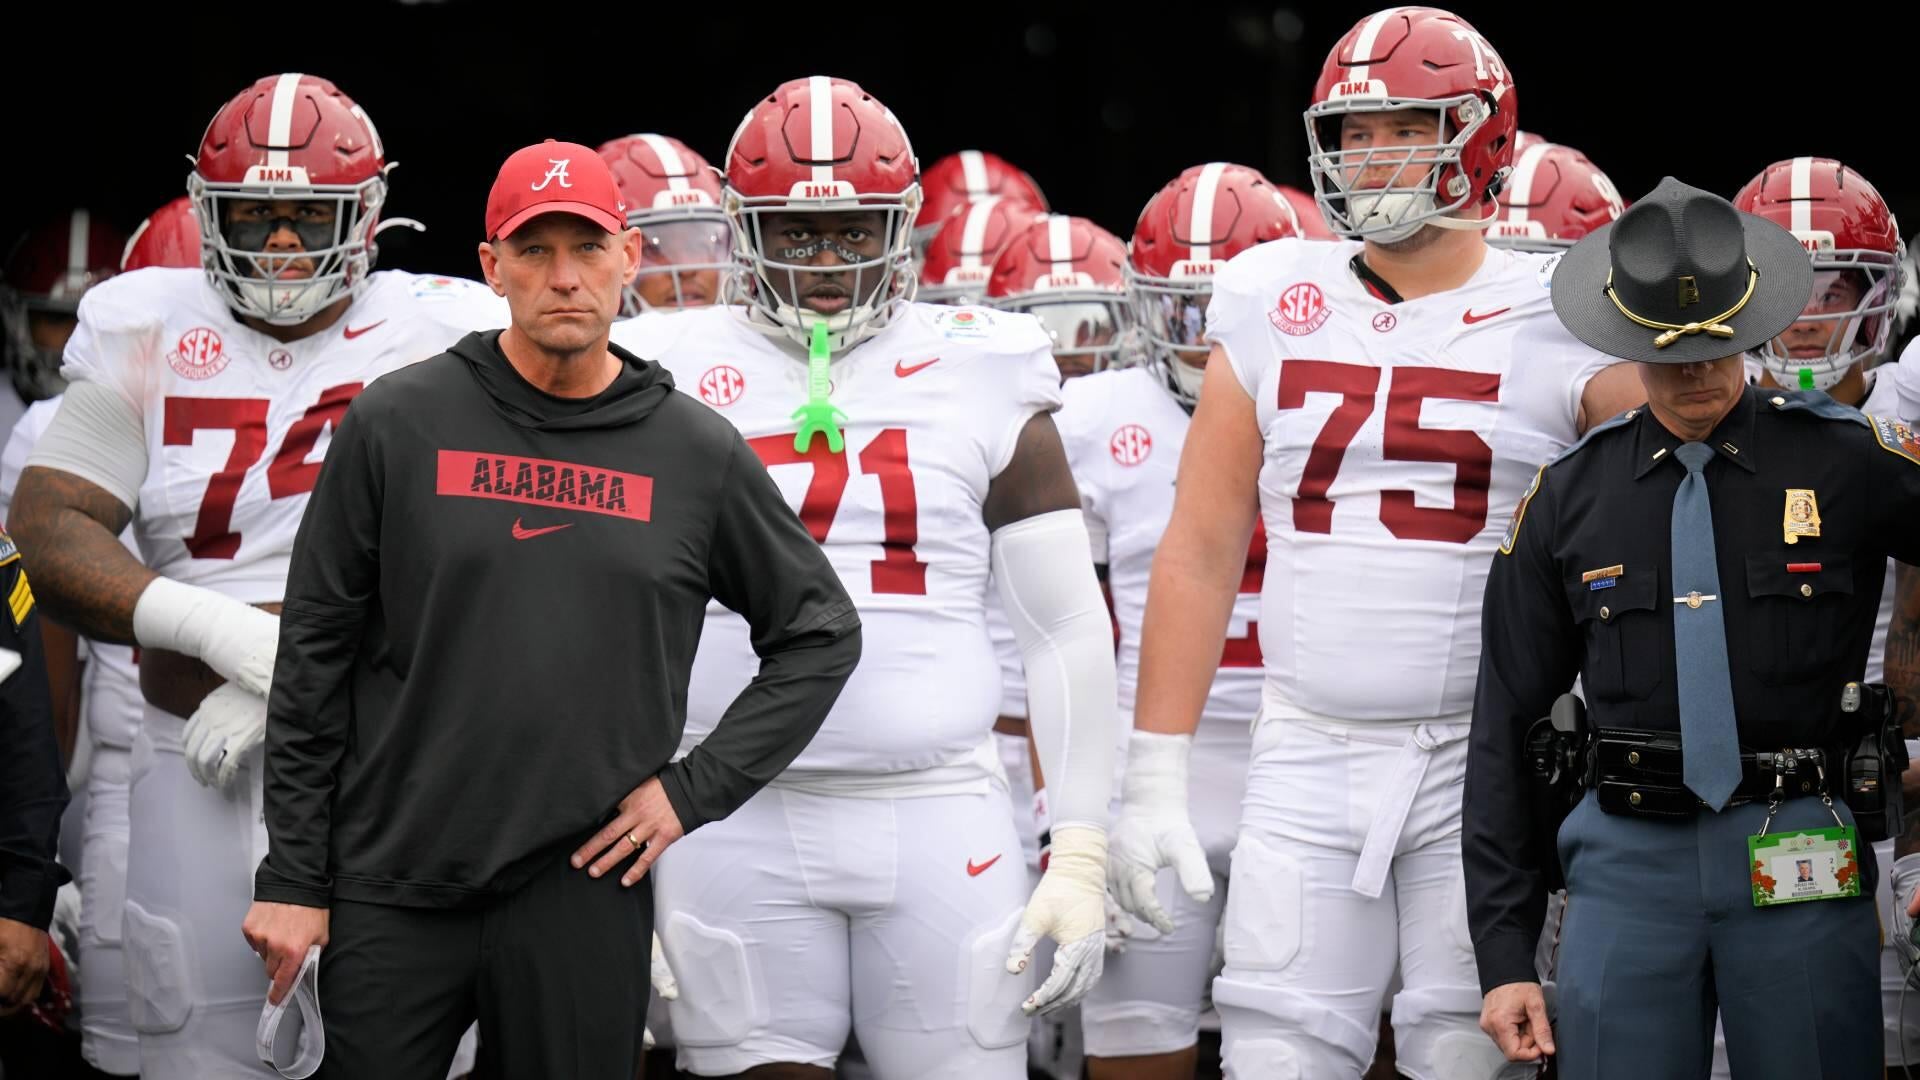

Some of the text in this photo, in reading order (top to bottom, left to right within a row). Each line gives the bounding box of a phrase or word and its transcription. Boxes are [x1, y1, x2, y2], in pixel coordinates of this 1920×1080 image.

[1452, 30, 1505, 81] 75
[1340, 81, 1370, 96] BAMA
[259, 169, 293, 182] BAMA
[531, 158, 573, 191] A
[805, 185, 839, 198] BAMA
[1500, 226, 1529, 237] BAMA
[1800, 239, 1818, 251] MA
[1184, 263, 1215, 275] BAMA
[1280, 284, 1322, 322] SEC
[180, 329, 222, 366] SEC
[700, 366, 743, 405] SEC
[1111, 426, 1151, 466] SEC
[1278, 359, 1501, 544] 75
[163, 382, 364, 560] 74
[471, 457, 627, 513] ALABAMA
[746, 428, 929, 596] 71
